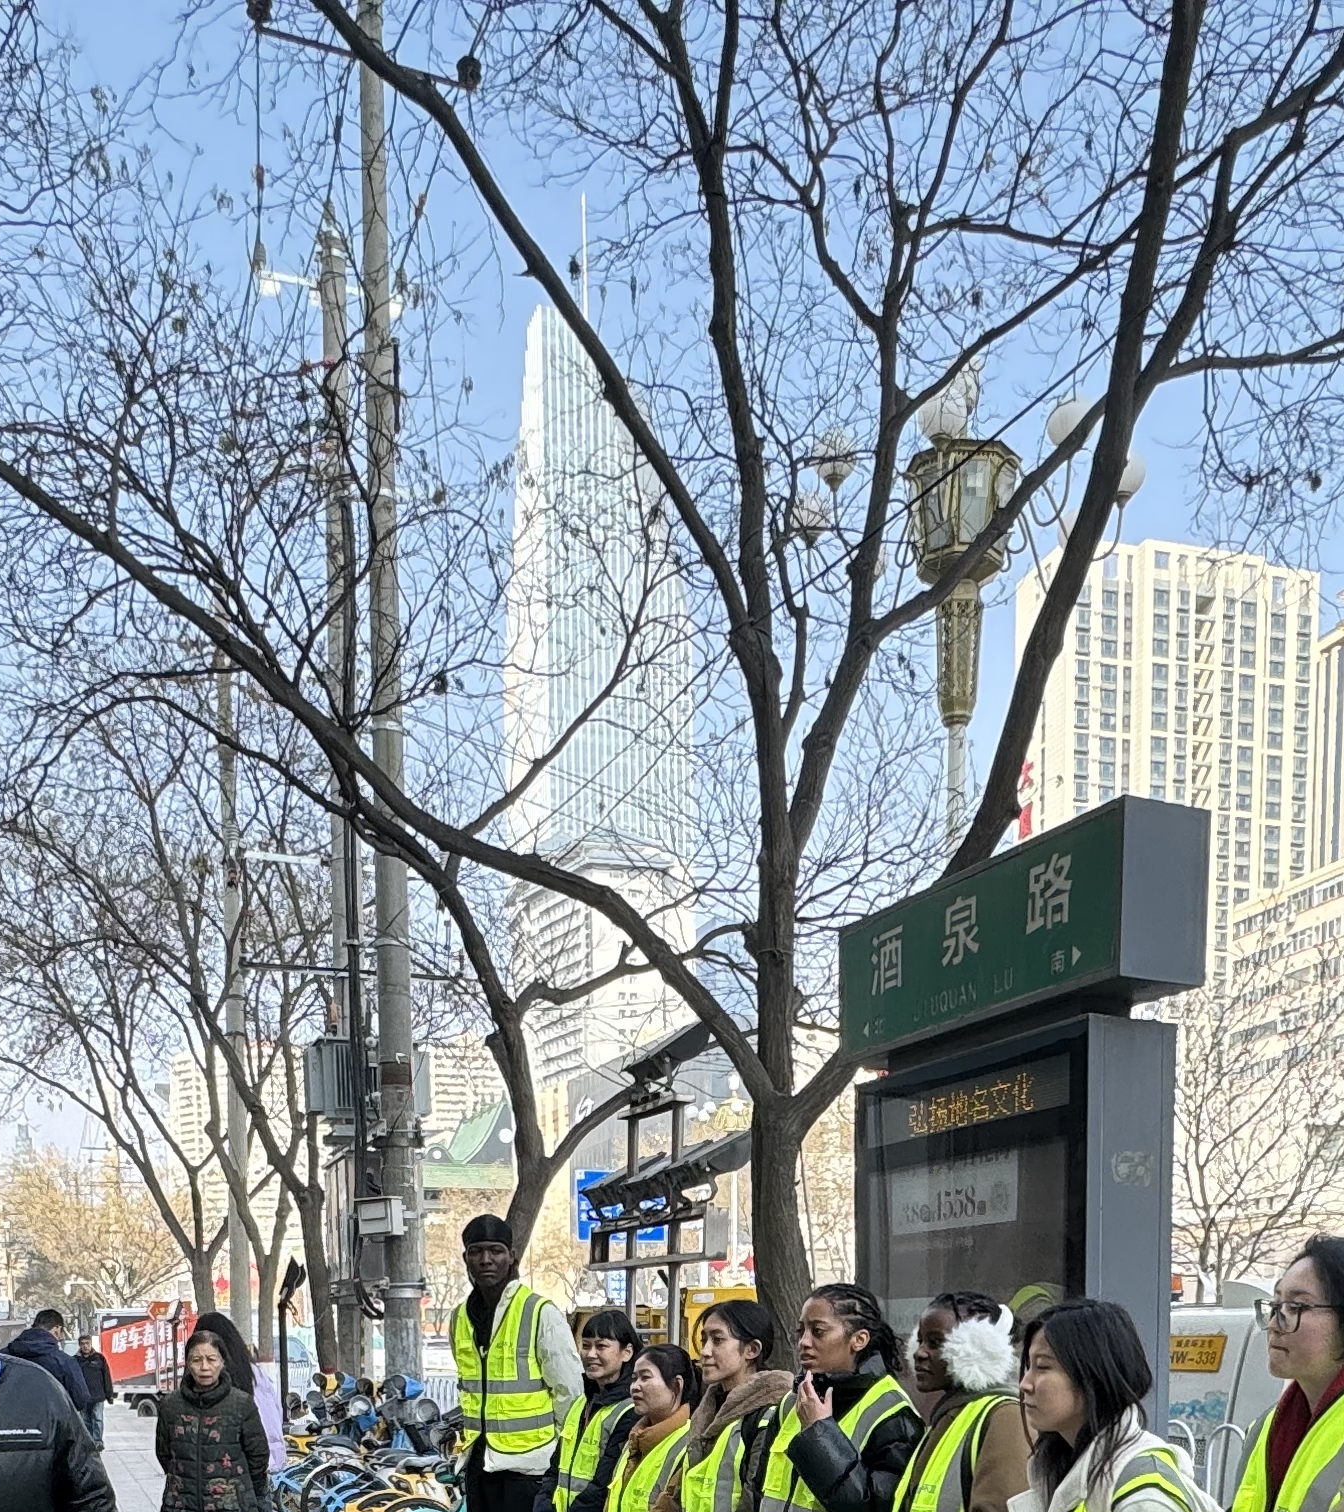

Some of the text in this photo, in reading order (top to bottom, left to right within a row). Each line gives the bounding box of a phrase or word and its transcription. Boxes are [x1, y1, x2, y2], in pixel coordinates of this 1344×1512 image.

[870, 852, 1073, 996] 酒泉路
[1051, 949, 1066, 974] 南
[994, 966, 1014, 995] LU
